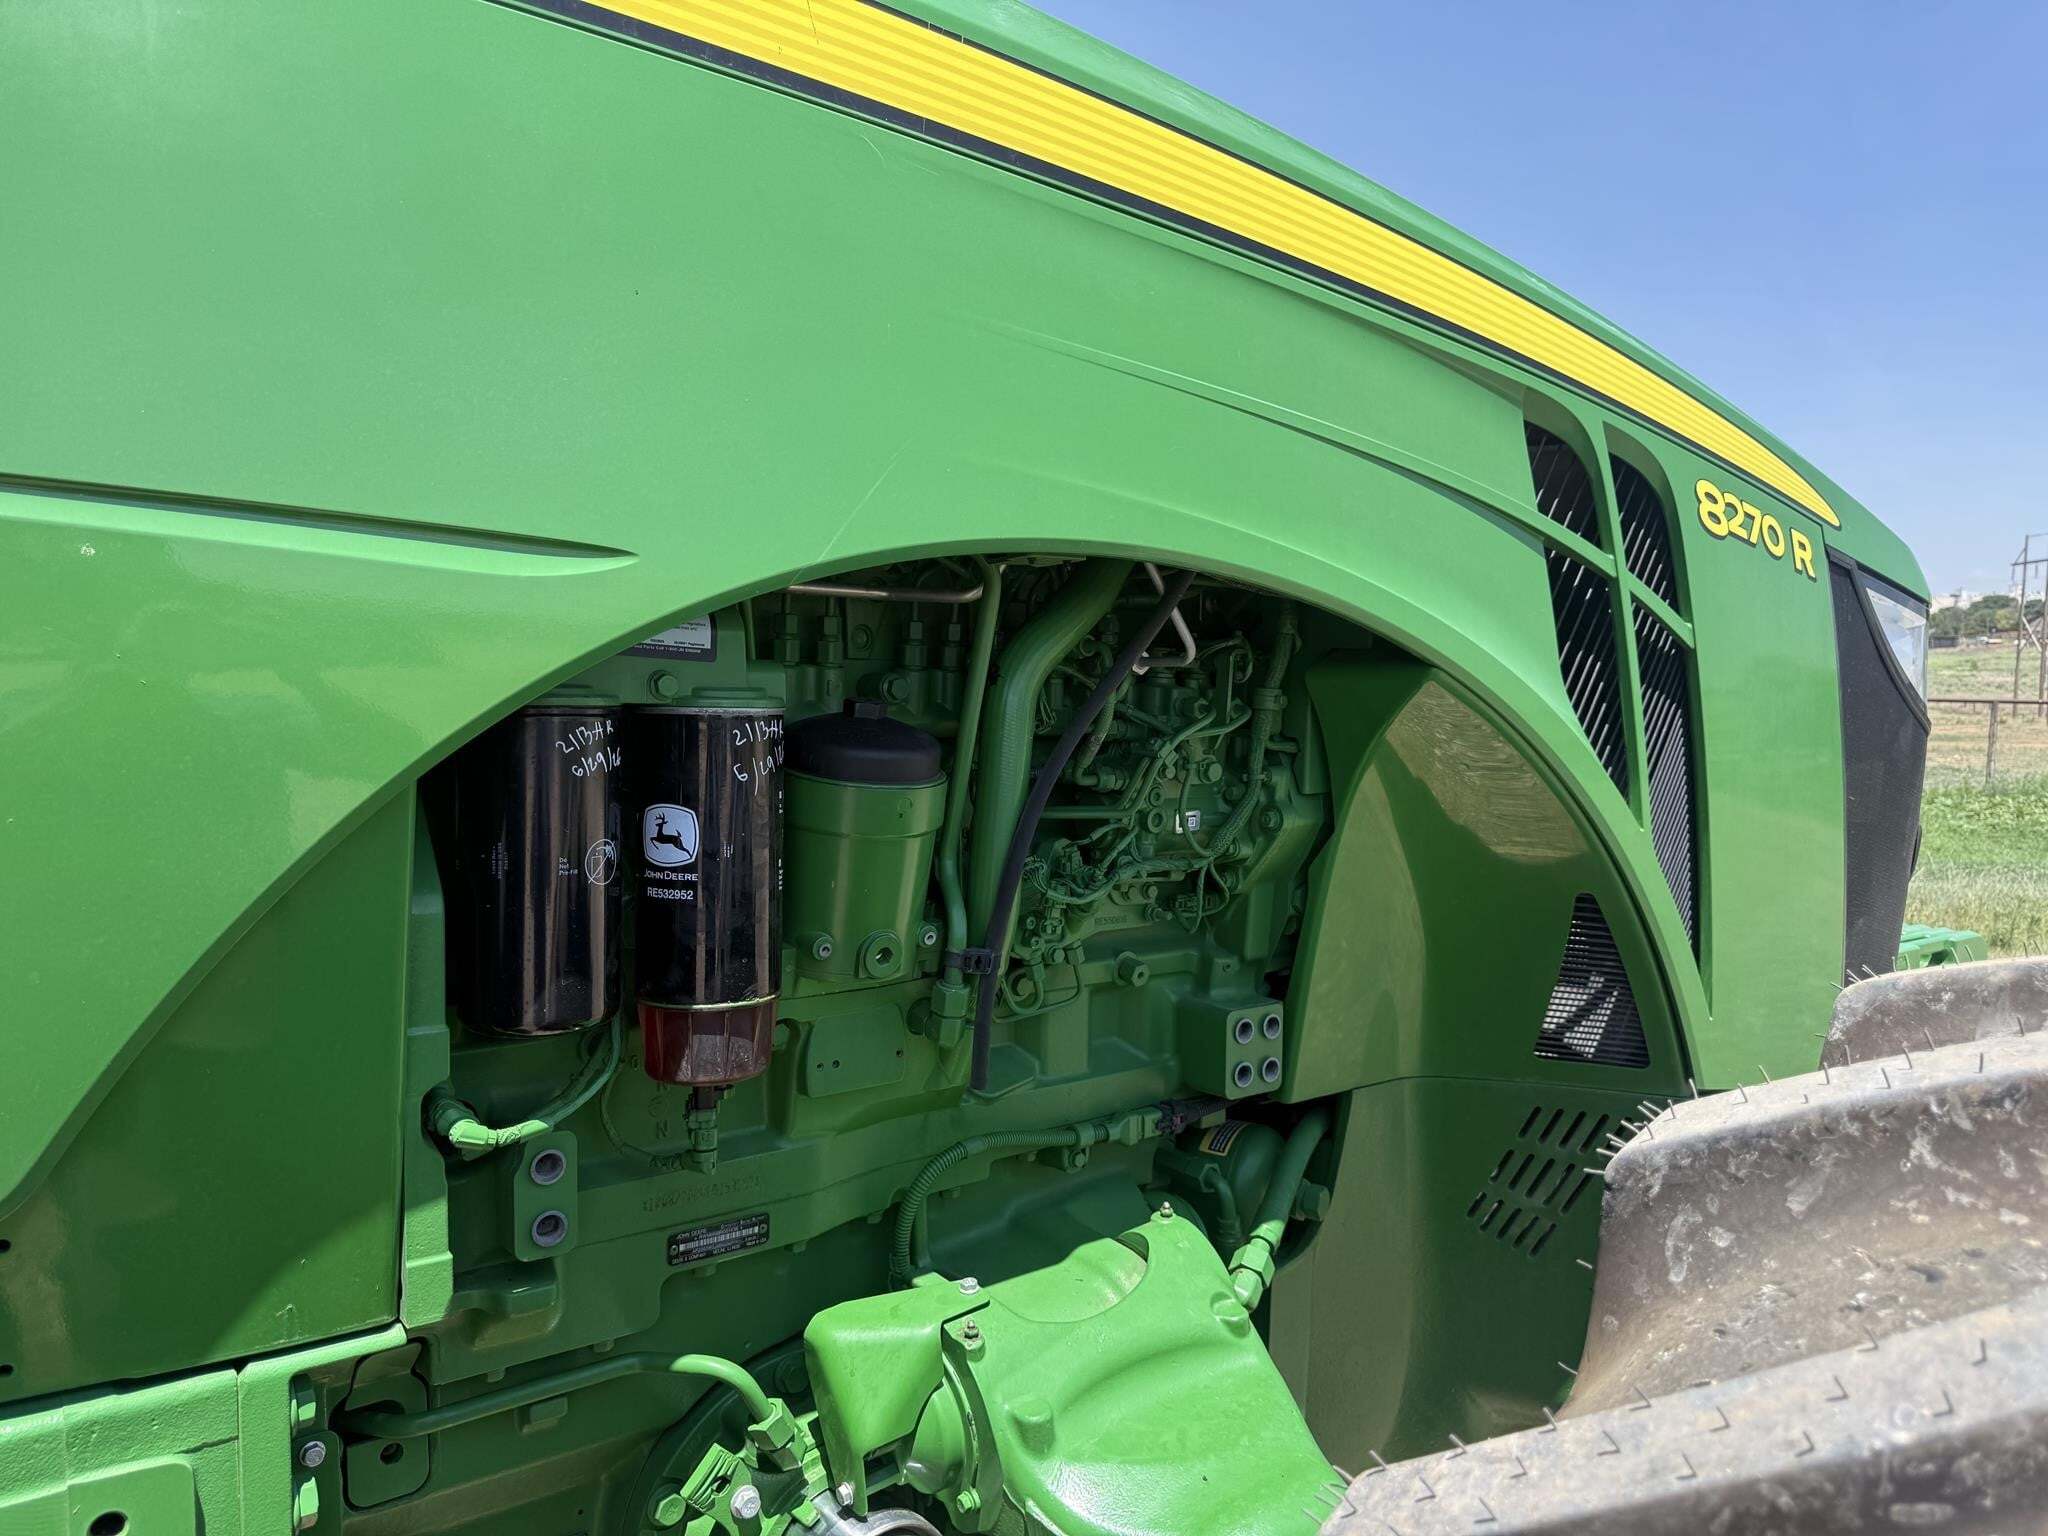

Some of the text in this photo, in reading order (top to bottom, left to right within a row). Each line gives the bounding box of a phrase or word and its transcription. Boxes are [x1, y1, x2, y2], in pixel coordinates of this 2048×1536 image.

[1695, 479, 1816, 581] 8270 R
[644, 868, 699, 881] JOHN DEERE
[647, 886, 694, 900] RE532952
